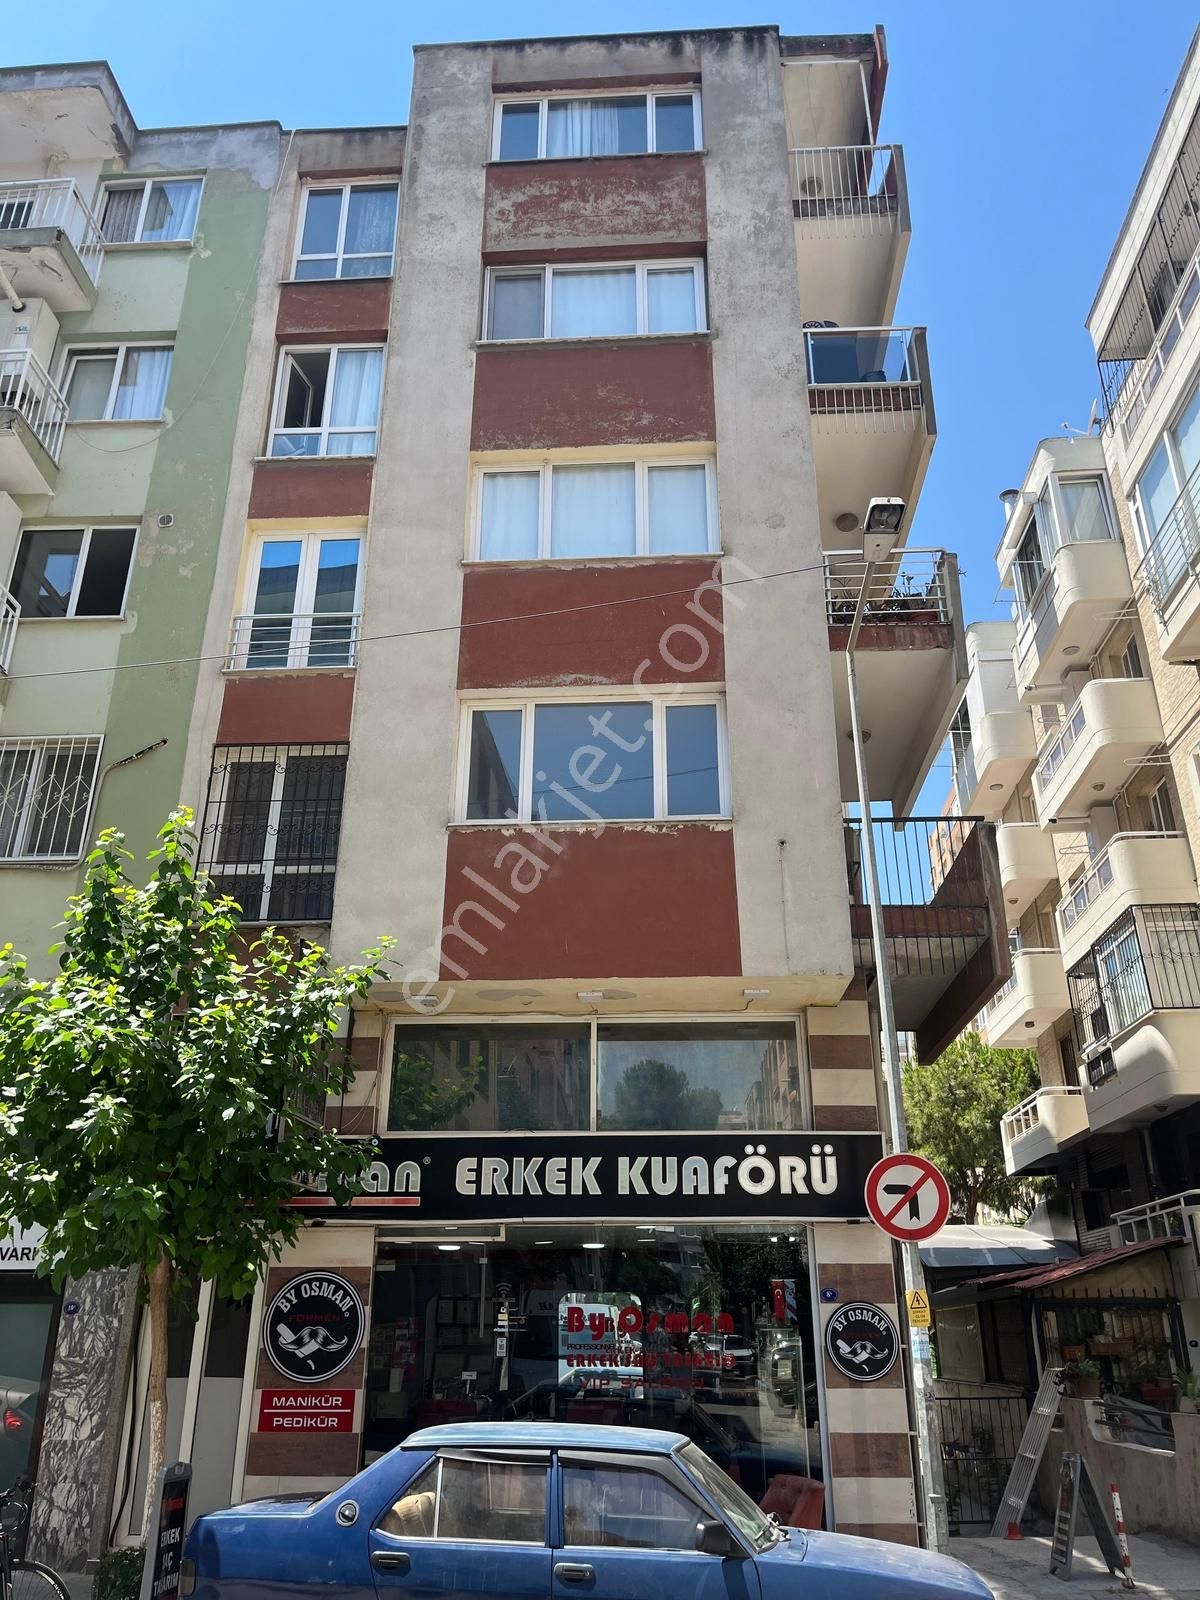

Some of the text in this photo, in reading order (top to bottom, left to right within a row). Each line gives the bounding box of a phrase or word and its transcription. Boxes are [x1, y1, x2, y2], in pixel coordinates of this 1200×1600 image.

[455, 1156, 603, 1196] ERKEK
[617, 1143, 839, 1196] KUAFÖRÜ
[277, 1281, 354, 1313] BY OSMAN
[567, 1306, 606, 1341] By
[833, 1309, 888, 1332] BY OSMAN
[566, 1353, 620, 1368] ERKEK
[580, 1378, 609, 1390] VIP
[272, 1394, 343, 1407] MANİKÜR
[273, 1415, 338, 1428] PEDİKÜR
